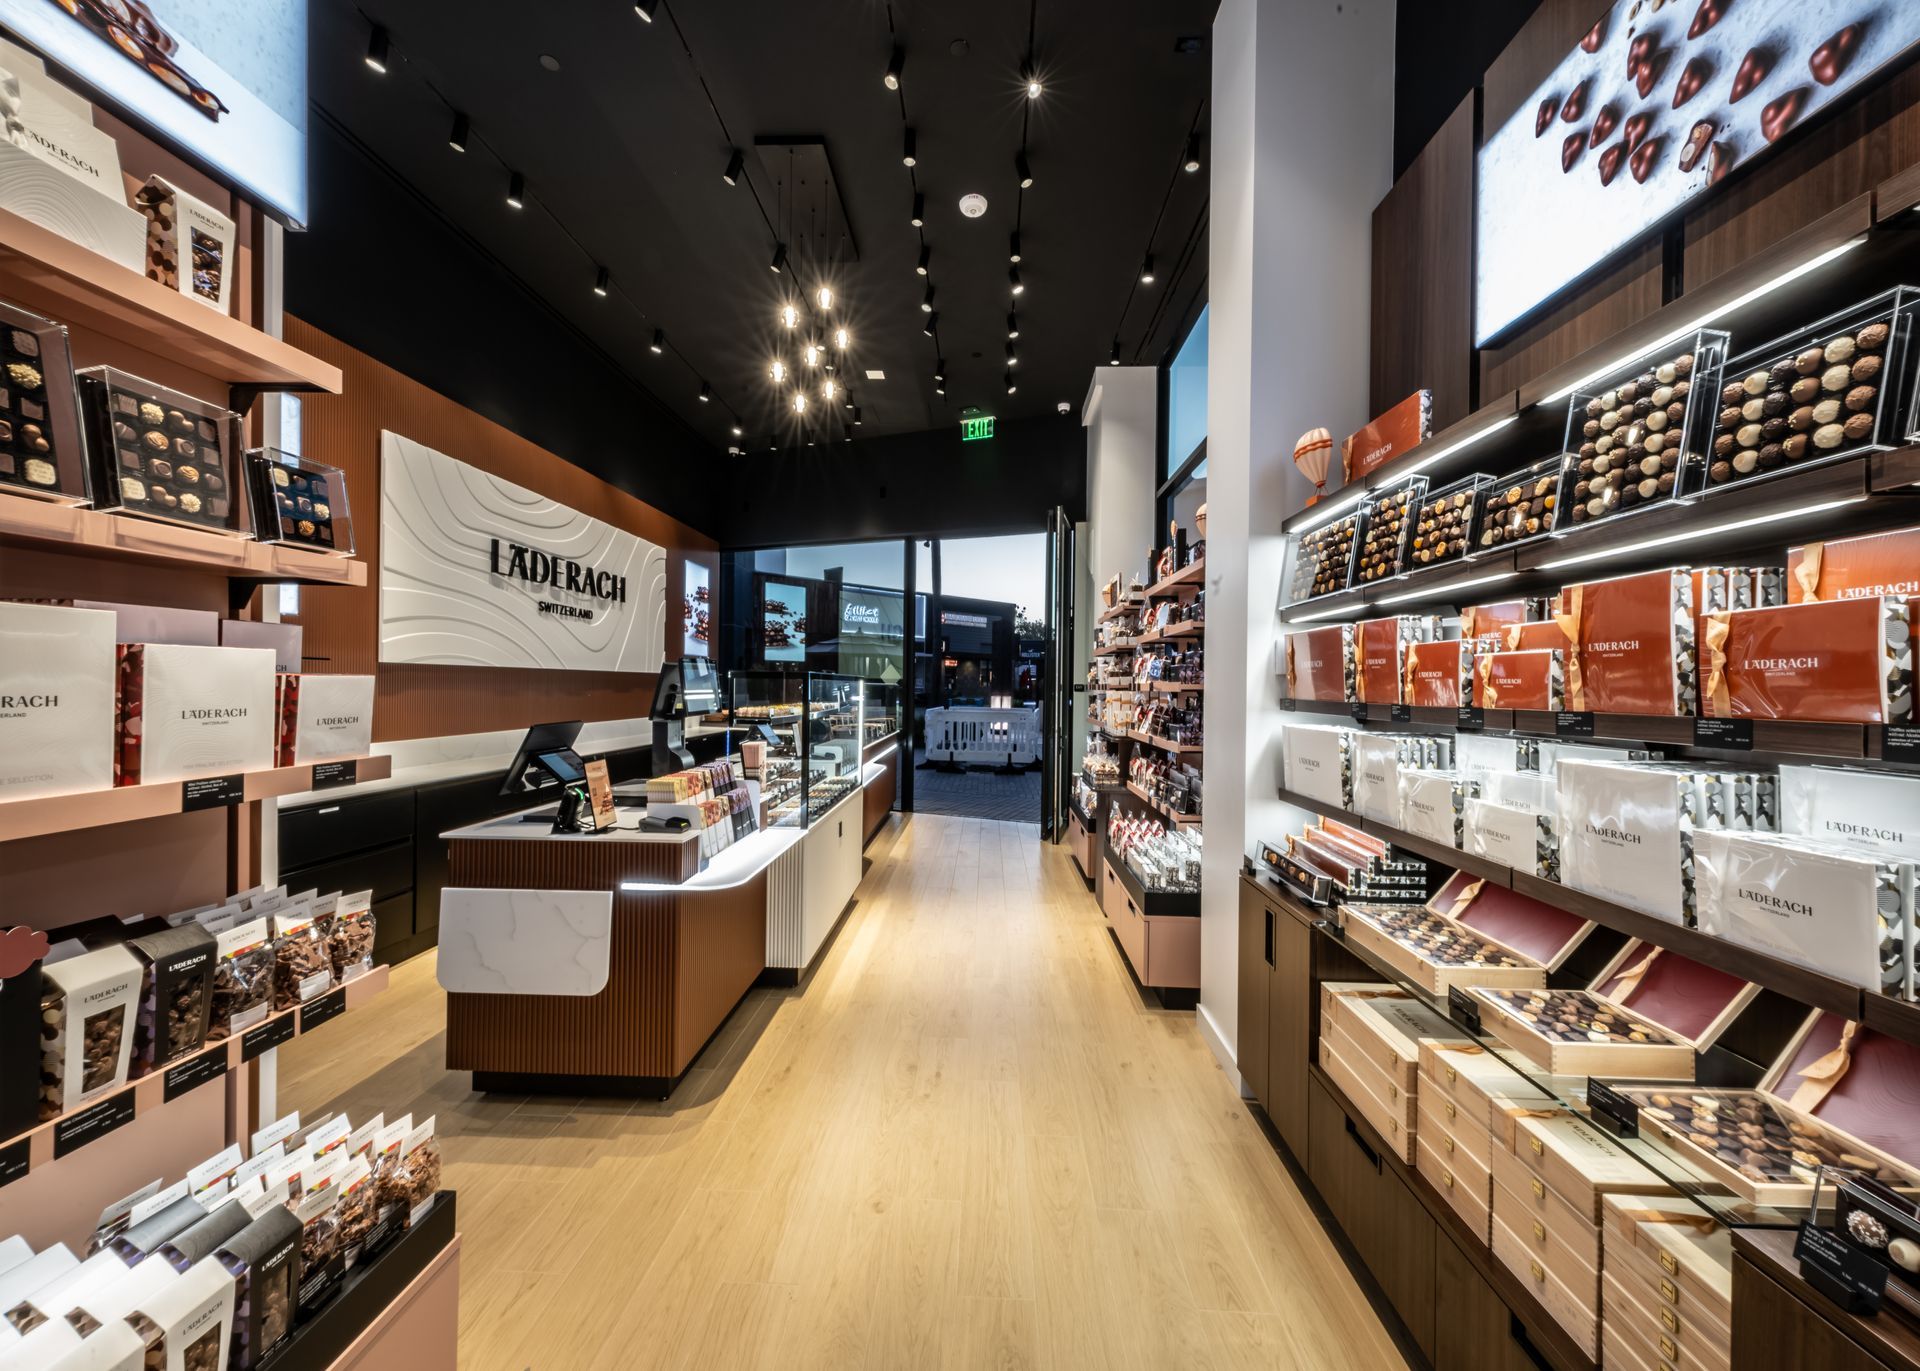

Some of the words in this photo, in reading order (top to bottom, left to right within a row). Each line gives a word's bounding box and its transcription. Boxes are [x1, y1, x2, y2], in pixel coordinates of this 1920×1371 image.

[968, 419, 989, 438] EXIT
[491, 539, 626, 603] LÄDERACH
[538, 601, 593, 619] SWITZERLAND
[1588, 640, 1639, 652] LÄDERACH
[1744, 657, 1818, 670] LÄDERACH
[182, 708, 247, 720] LÄDERACH
[316, 716, 359, 726] LÄDERACH
[1826, 820, 1903, 843] LÄDERACH
[1738, 888, 1812, 916] LÄDERACH
[169, 954, 207, 972] LÄDERACH
